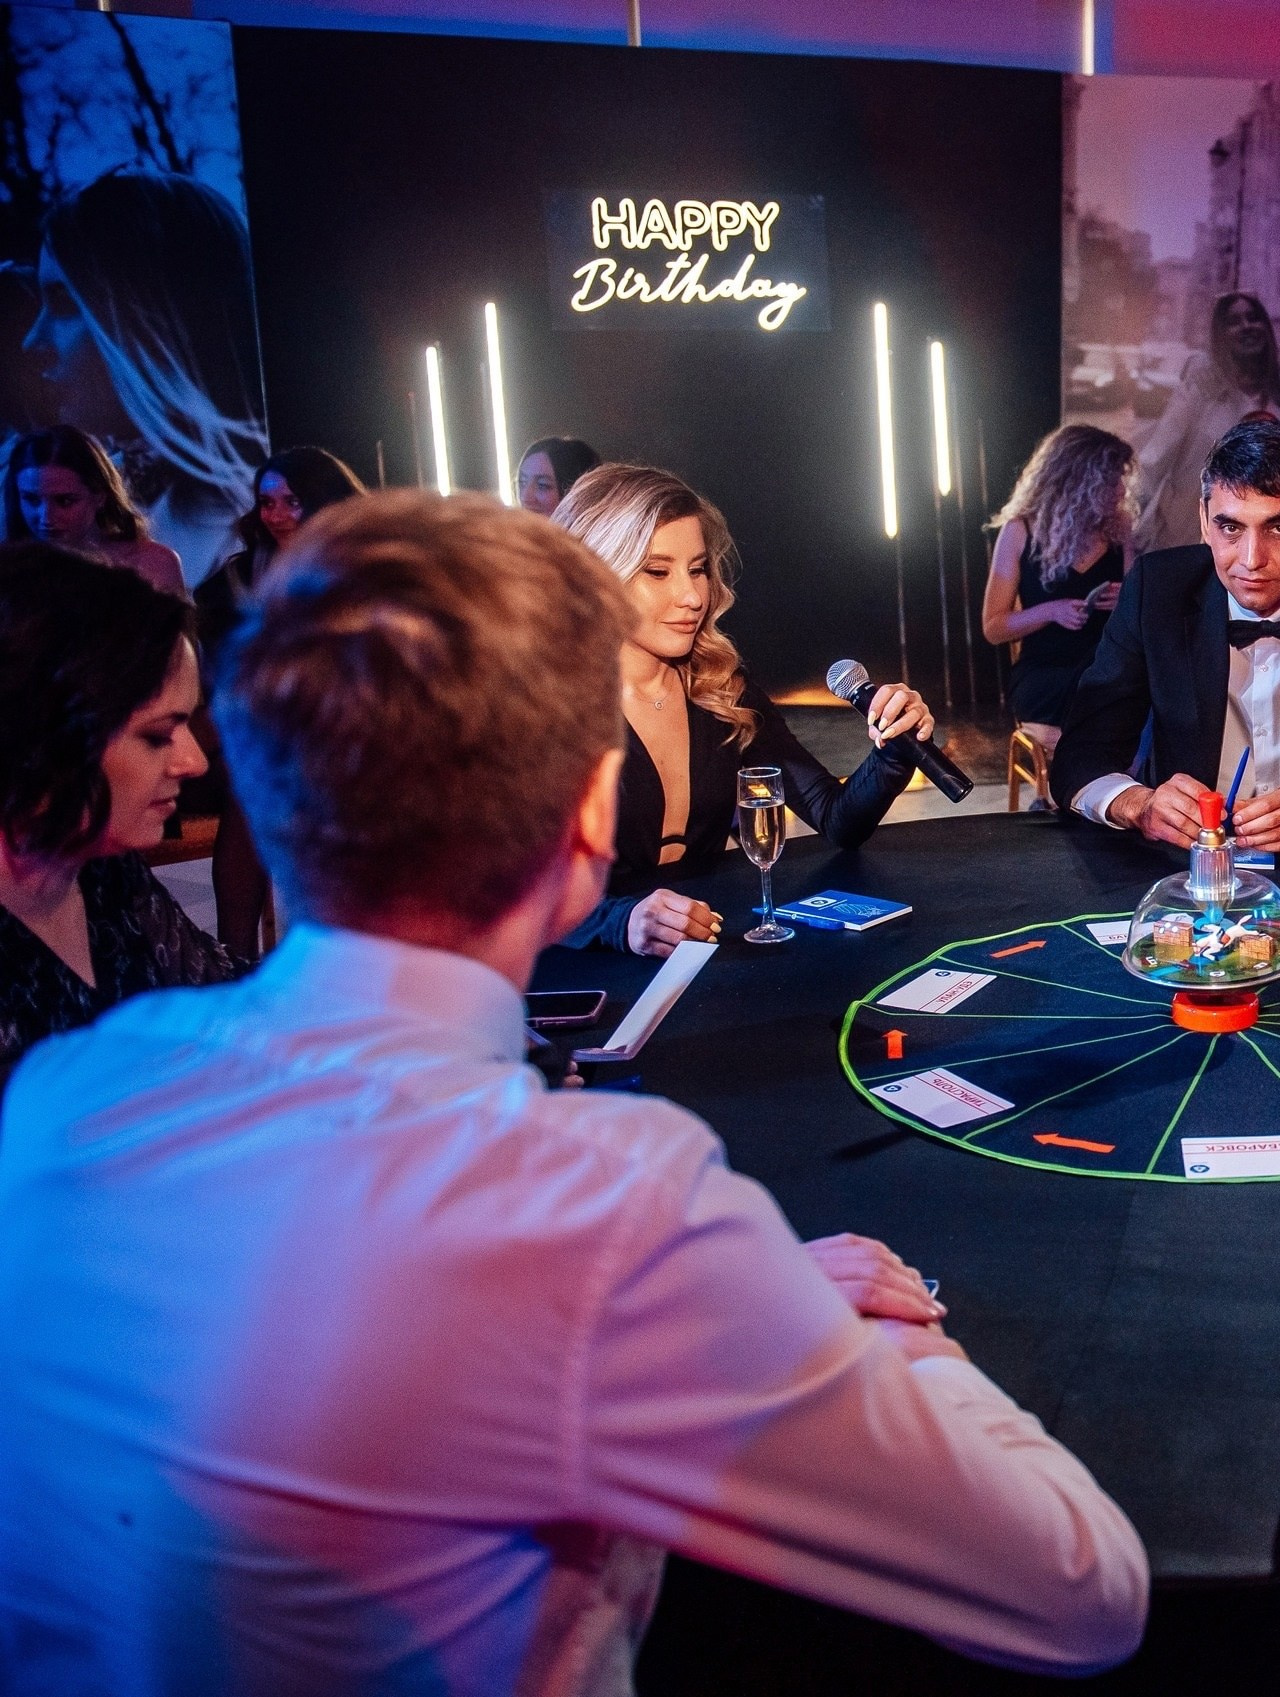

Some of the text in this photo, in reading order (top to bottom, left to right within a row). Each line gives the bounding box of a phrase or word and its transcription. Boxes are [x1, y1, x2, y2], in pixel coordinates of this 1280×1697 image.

[591, 197, 780, 252] HAPPY
[571, 252, 807, 331] Birthday
[932, 1078, 986, 1107] ТИРАСПОЛЬ
